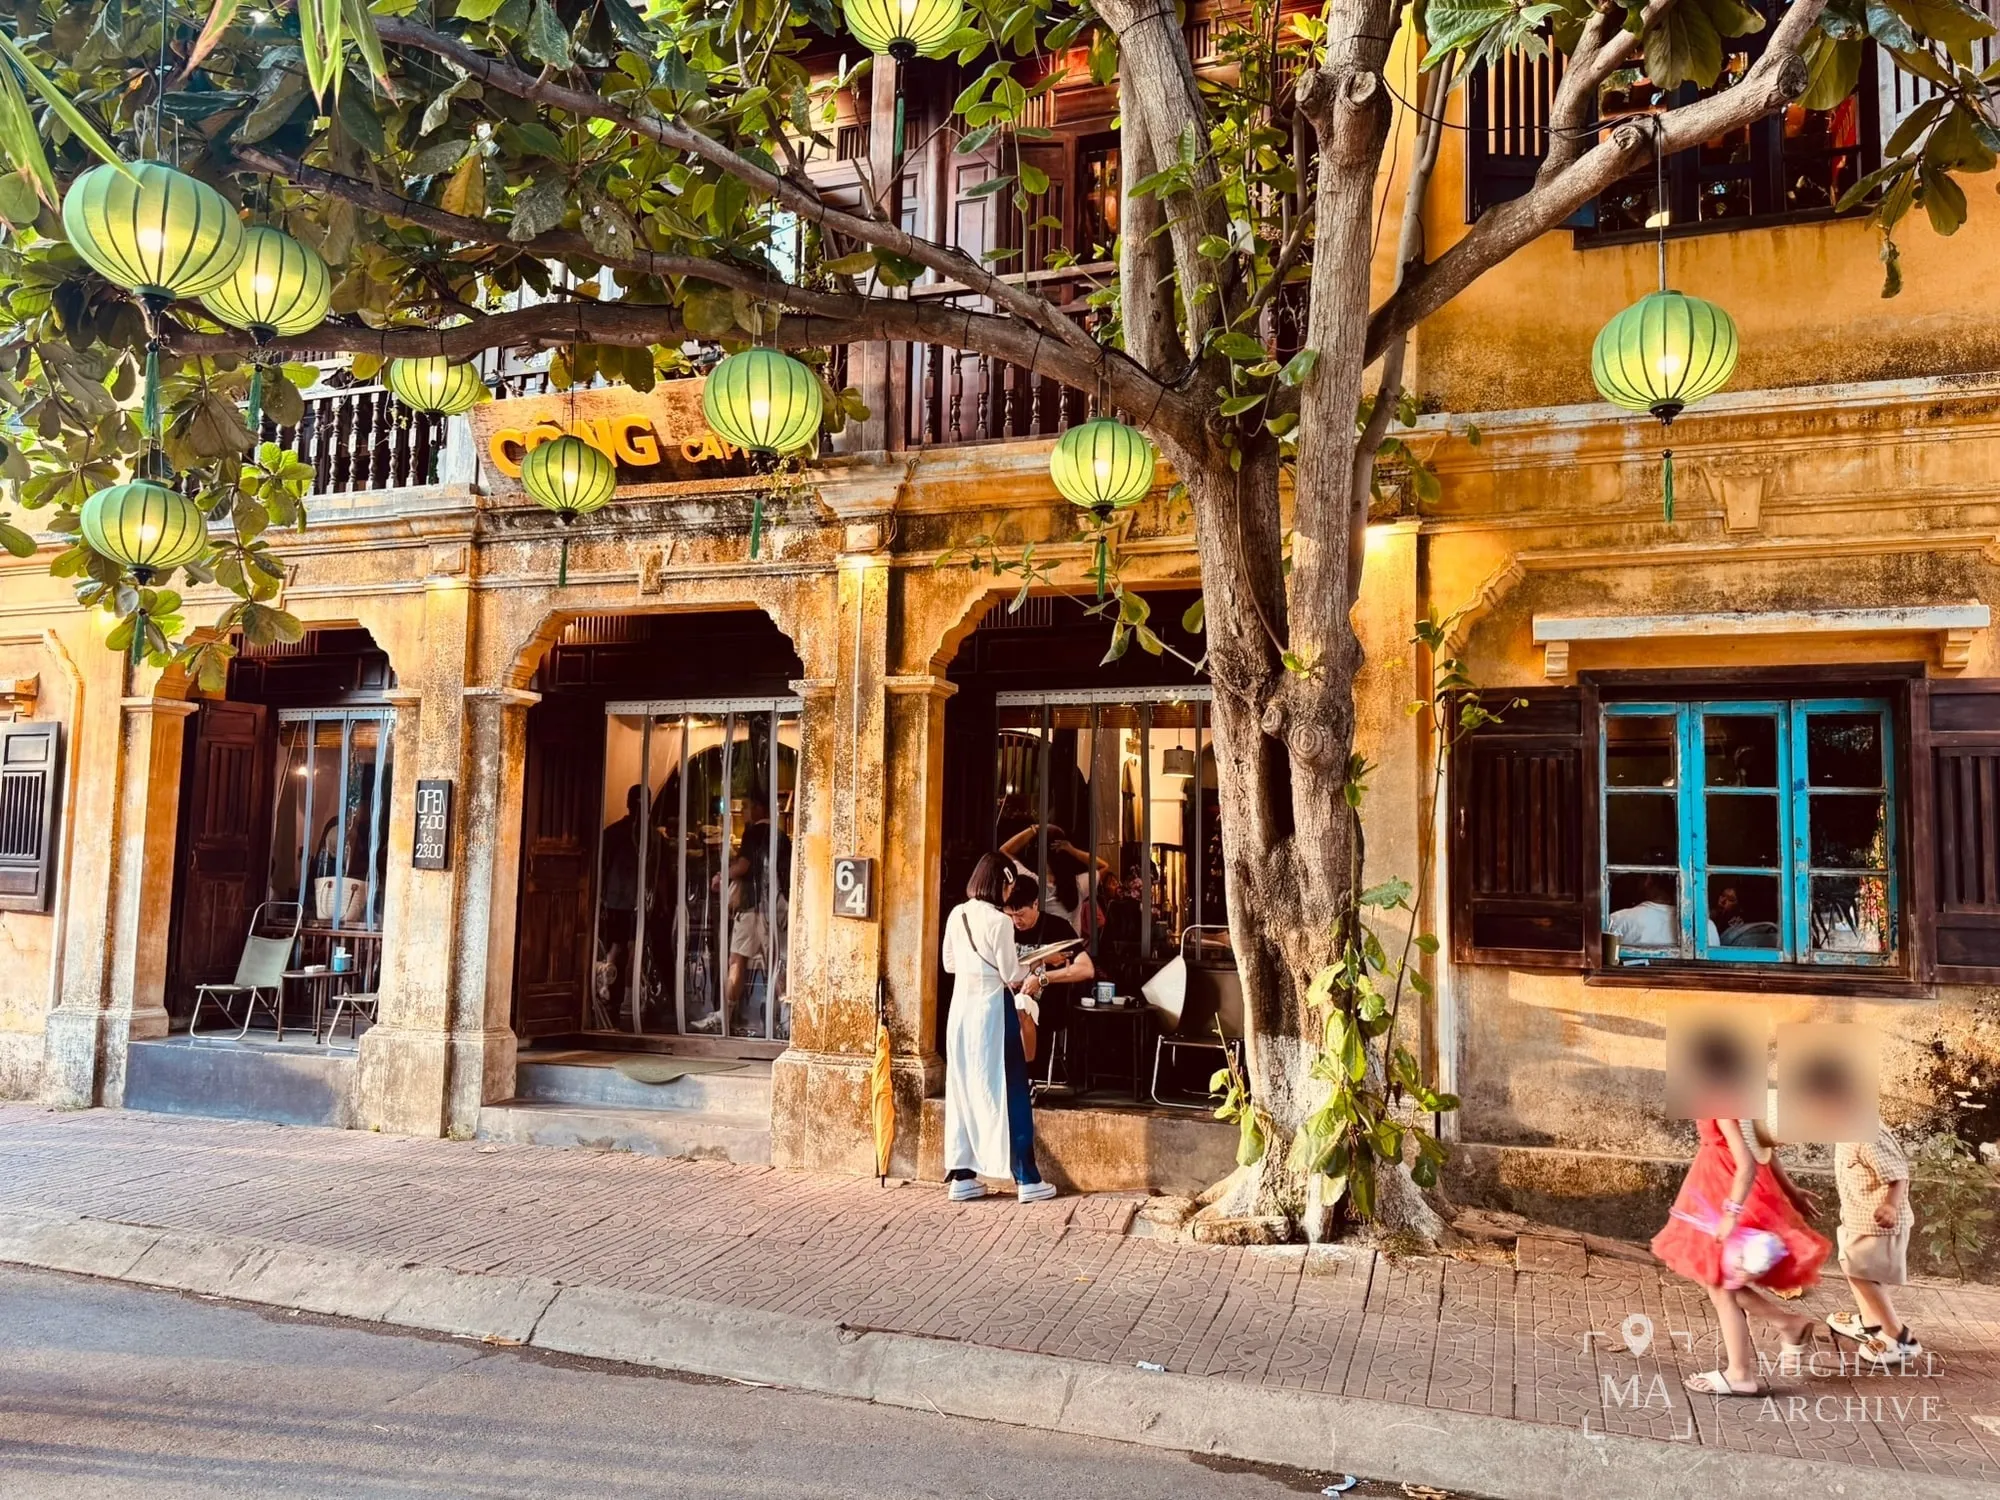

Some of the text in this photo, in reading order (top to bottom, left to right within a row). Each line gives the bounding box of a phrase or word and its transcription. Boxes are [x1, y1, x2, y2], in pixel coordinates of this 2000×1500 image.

[417, 790, 446, 814] OPEN
[419, 815, 445, 830] 7:00
[422, 833, 433, 843] to
[415, 844, 443, 859] 23:00
